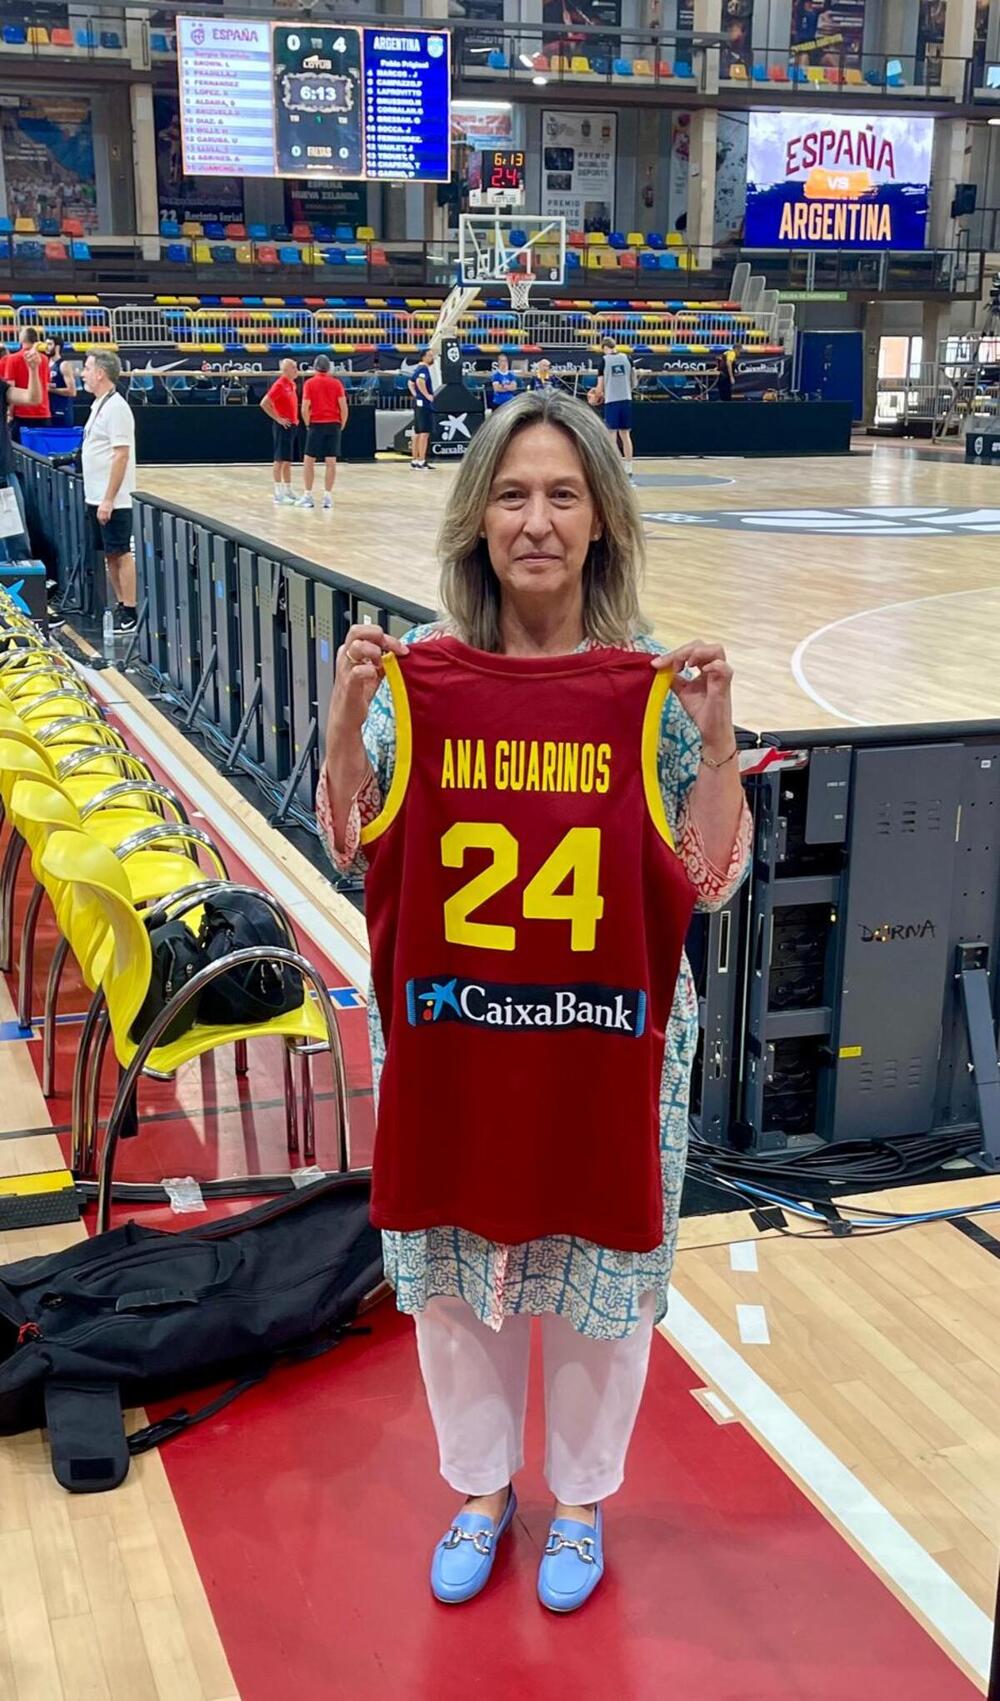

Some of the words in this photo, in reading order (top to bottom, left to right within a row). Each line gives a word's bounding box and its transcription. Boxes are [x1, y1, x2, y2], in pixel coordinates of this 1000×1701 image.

[212, 28, 258, 42] ESPAÑA
[287, 34, 301, 51] 0
[333, 36, 347, 53] 4
[373, 36, 421, 52] ARGENTINA
[300, 86, 336, 101] 6:13
[291, 145, 302, 157] 0
[339, 147, 349, 159] 0
[786, 124, 896, 178] ESPAÑA
[494, 152, 523, 167] 6:13
[826, 177, 849, 190] VS
[778, 201, 892, 241] ARGENTINA
[663, 359, 706, 372] ndesa
[432, 443, 469, 455] CaixaBa
[441, 738, 487, 789] ANA
[495, 739, 611, 793] GUARINOS
[441, 822, 604, 951] 24
[460, 984, 633, 1031] CaixaBank
